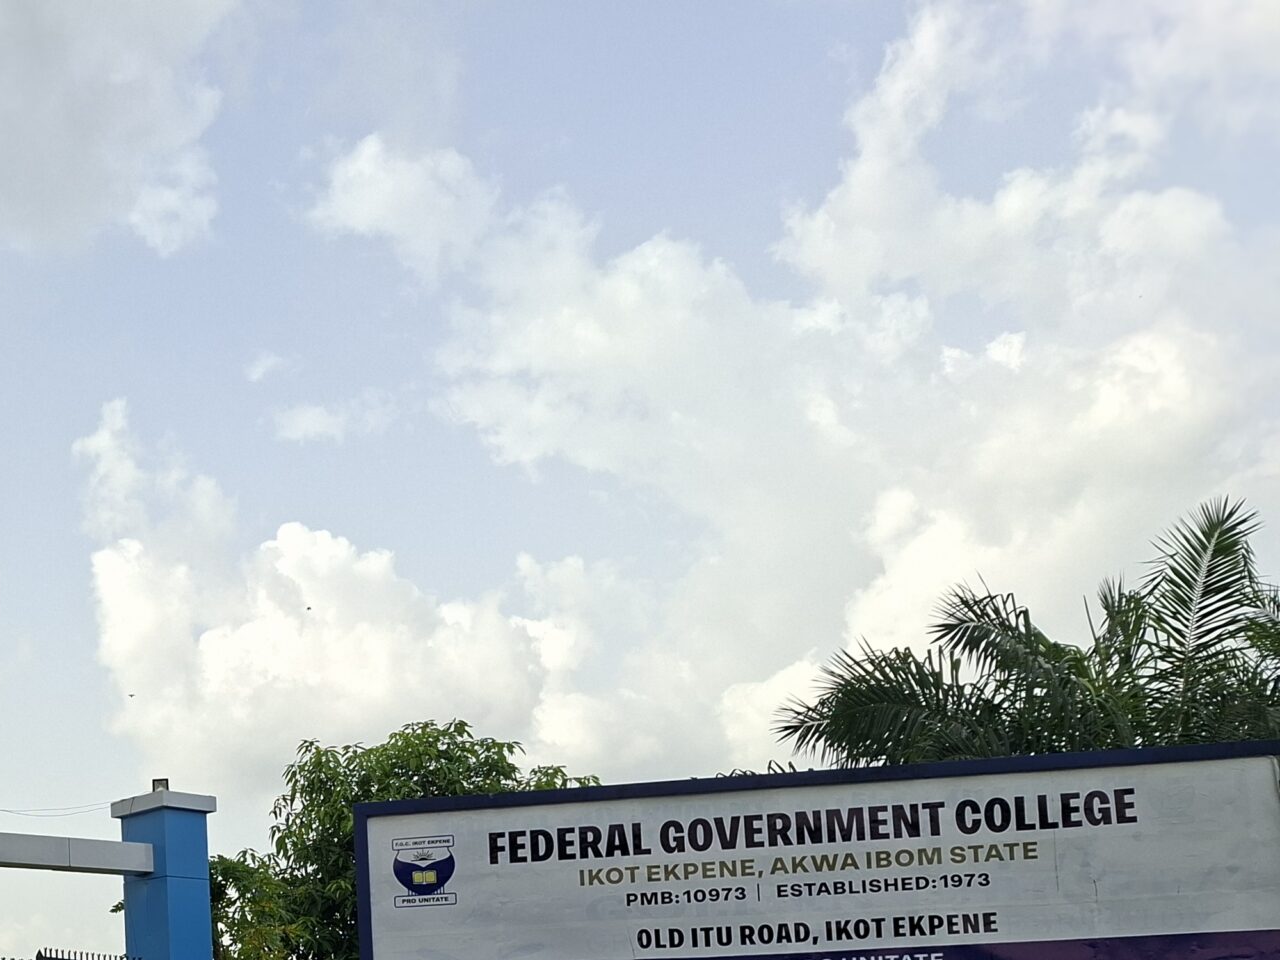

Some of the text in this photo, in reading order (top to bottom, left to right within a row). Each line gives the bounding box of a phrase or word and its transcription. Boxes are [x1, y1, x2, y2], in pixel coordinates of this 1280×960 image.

[488, 787, 1138, 865] FEDERAL GOVERNMENT COLLEGE
[578, 841, 1039, 887] IKOT EKPENE, AKWA IBOM STATE
[625, 872, 991, 907] PMB:10973 ESTABLISHED:1973
[636, 911, 999, 951] OLD ITU ROAD, IKOT EKPENE
